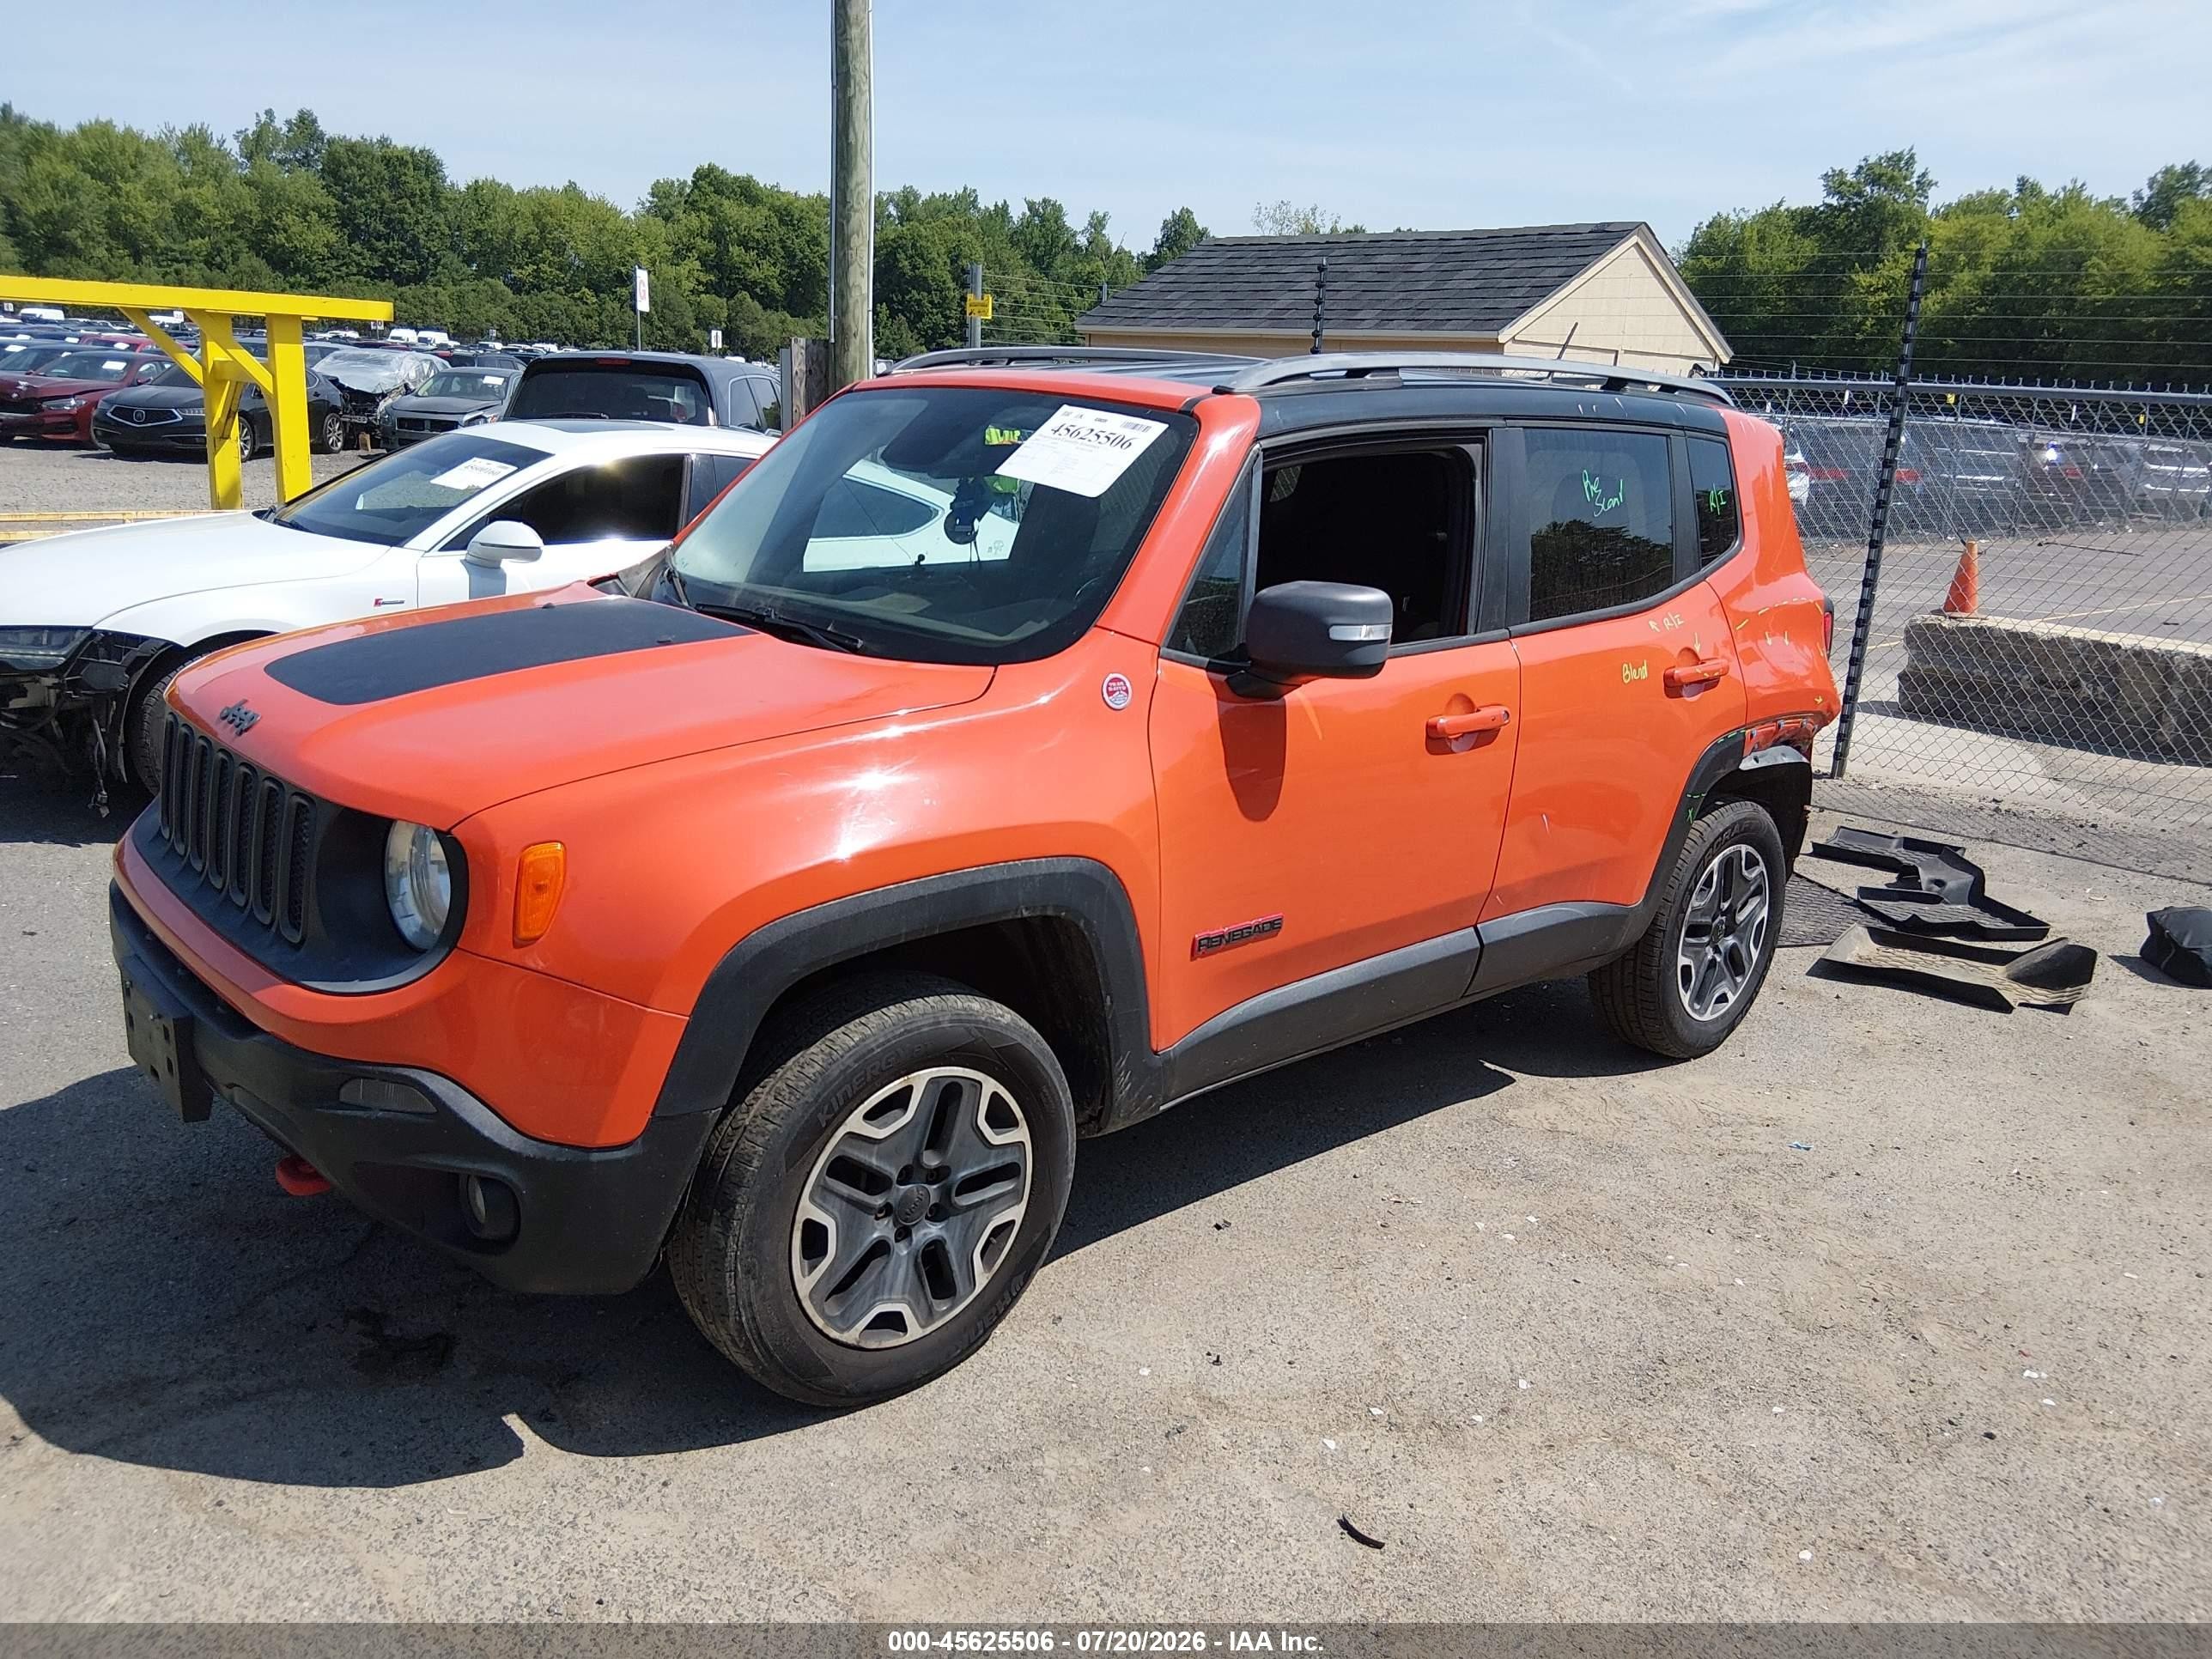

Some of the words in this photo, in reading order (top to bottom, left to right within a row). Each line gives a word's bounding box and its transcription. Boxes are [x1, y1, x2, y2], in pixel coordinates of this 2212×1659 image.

[638, 279, 647, 301] G
[1050, 422, 1141, 451] 45625506
[1582, 469, 1602, 502] Pre
[1709, 483, 1727, 515] R/I
[1622, 659, 1648, 684] Blend
[220, 698, 261, 737] Jeep
[1196, 915, 1283, 954] RENEGADE
